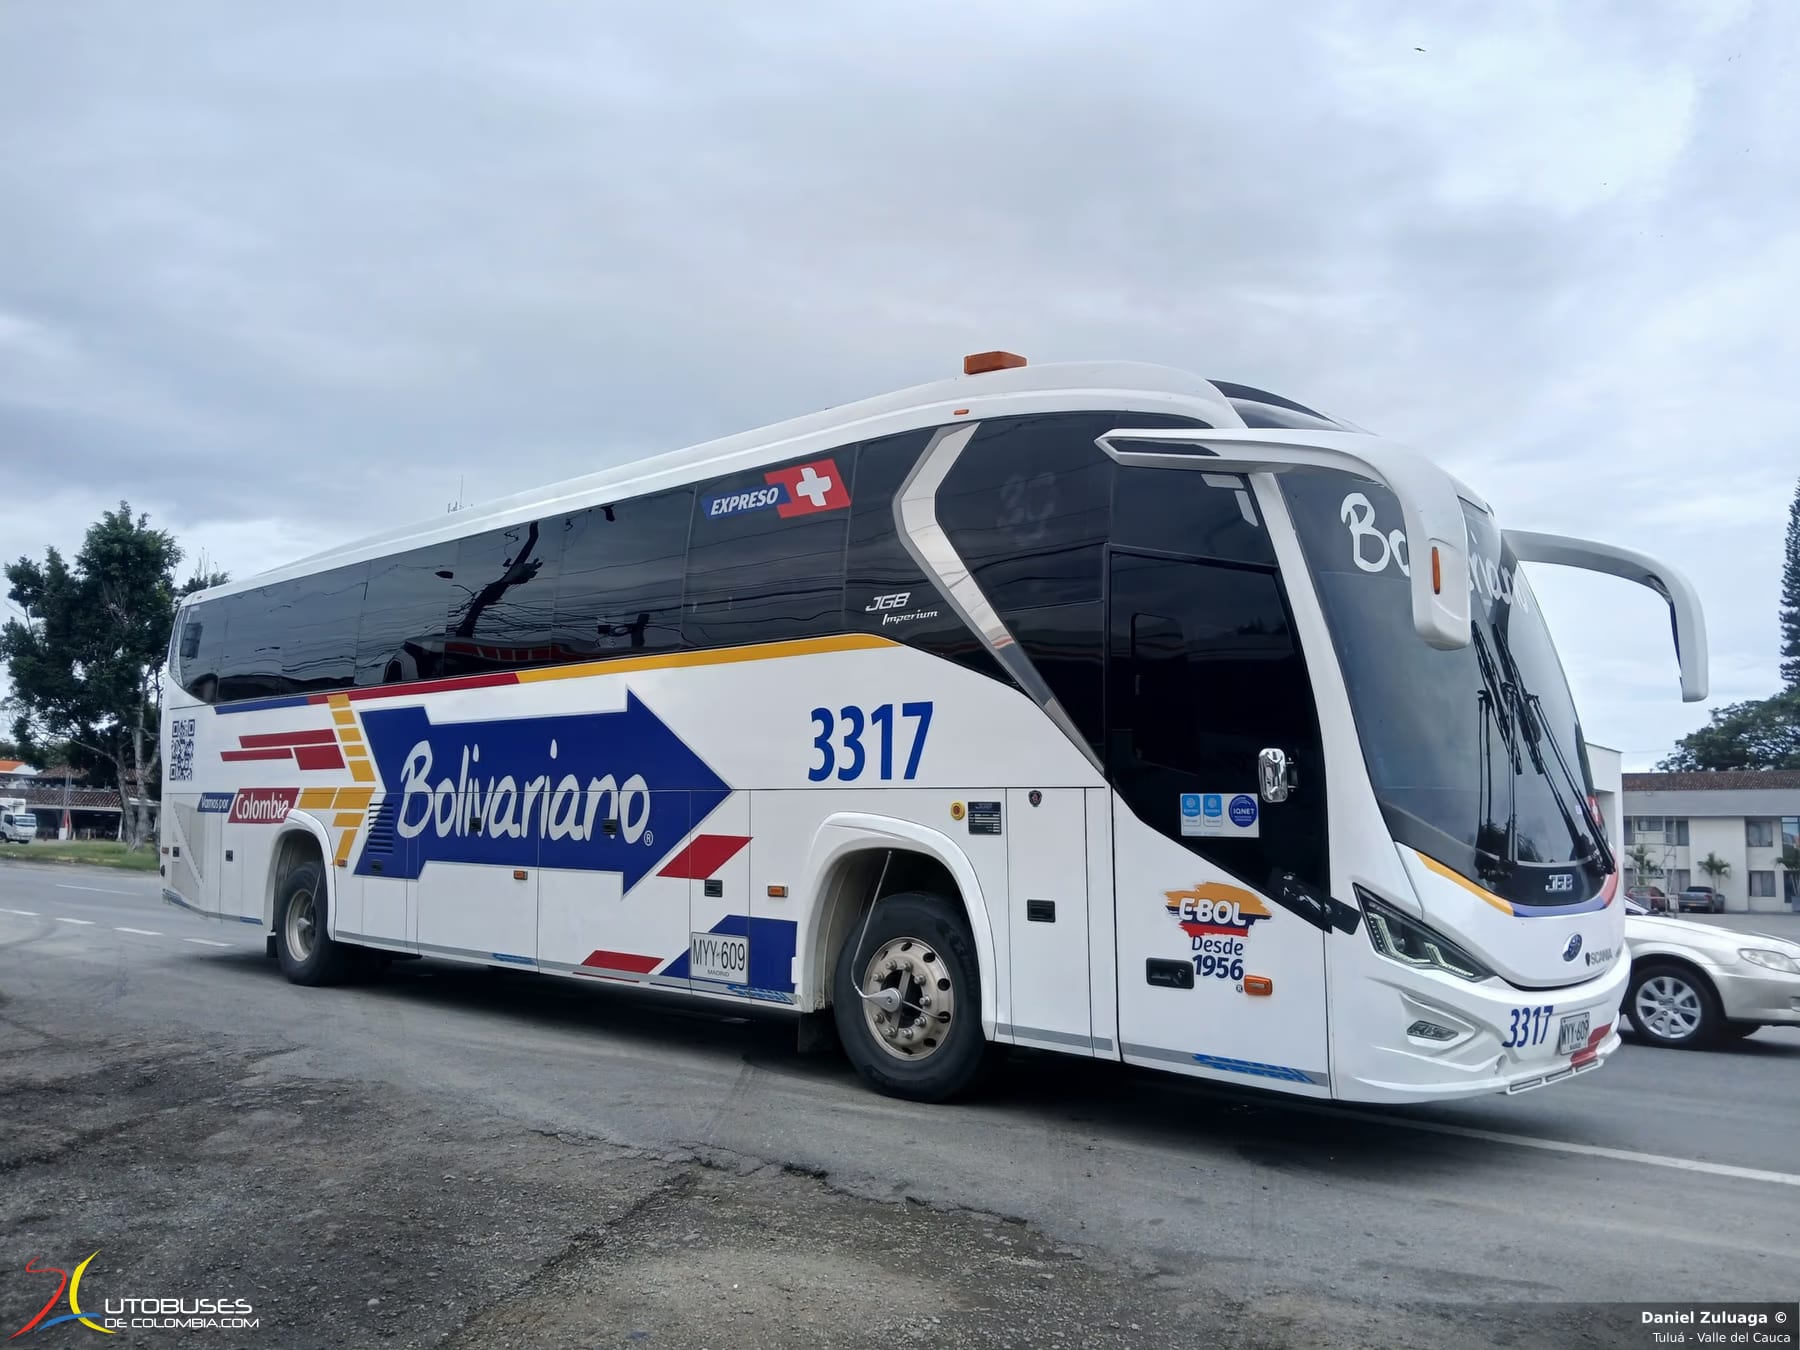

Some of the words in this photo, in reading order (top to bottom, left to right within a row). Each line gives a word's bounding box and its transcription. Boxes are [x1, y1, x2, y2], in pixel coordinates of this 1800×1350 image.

[710, 487, 779, 516] EXPRESO
[865, 592, 911, 612] JGB
[882, 609, 938, 626] Imperium
[807, 701, 934, 782] 3317
[396, 738, 651, 845] Bolivariano
[235, 791, 289, 820] Colombia
[1233, 807, 1255, 815] IQNET
[1191, 936, 1244, 956] Desde
[1192, 955, 1244, 981] 1956
[1501, 1005, 1554, 1048] 3317
